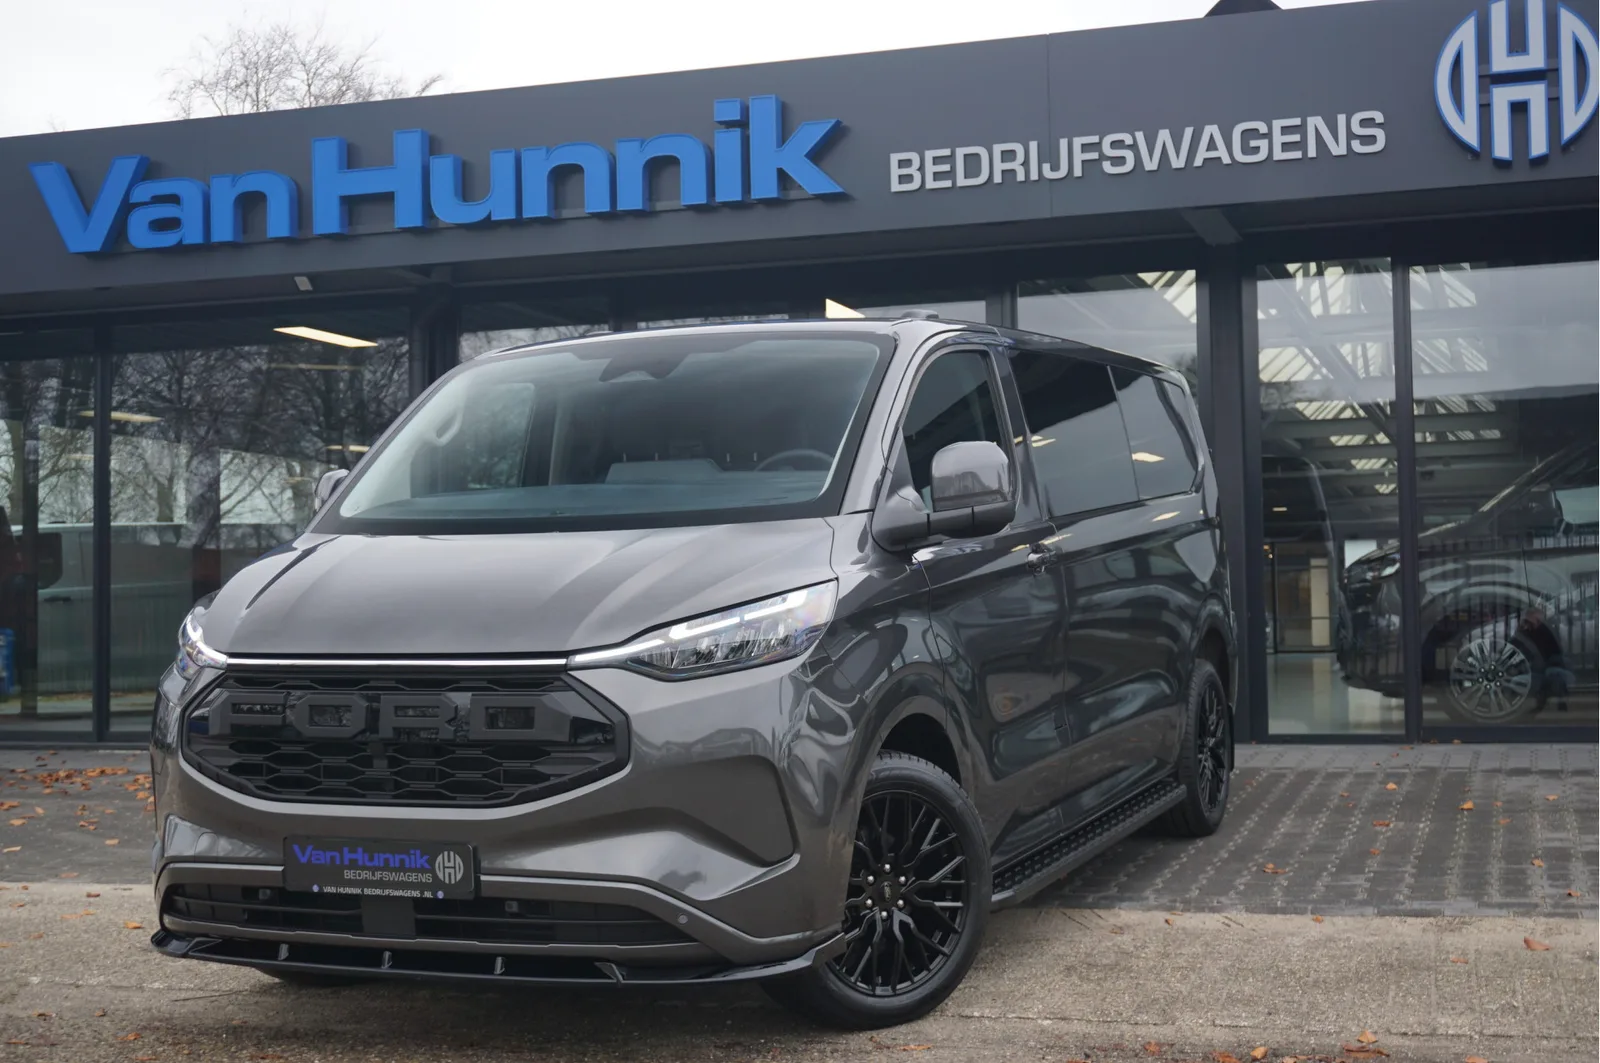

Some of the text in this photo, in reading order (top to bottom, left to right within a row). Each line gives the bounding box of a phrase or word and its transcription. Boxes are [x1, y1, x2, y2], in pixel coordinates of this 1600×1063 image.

[889, 109, 1387, 193] BEDRIJFSWAGENS
[29, 95, 843, 253] Van Hunnik
[212, 690, 569, 741] FORD
[293, 844, 340, 864] Van
[343, 847, 431, 869] Hunnik
[323, 886, 336, 894] VAN
[337, 887, 362, 896] HUNNIK
[363, 888, 421, 898] BEDRIJFSWAGENS
[344, 869, 432, 883] BEDRIJFSWAGENS
